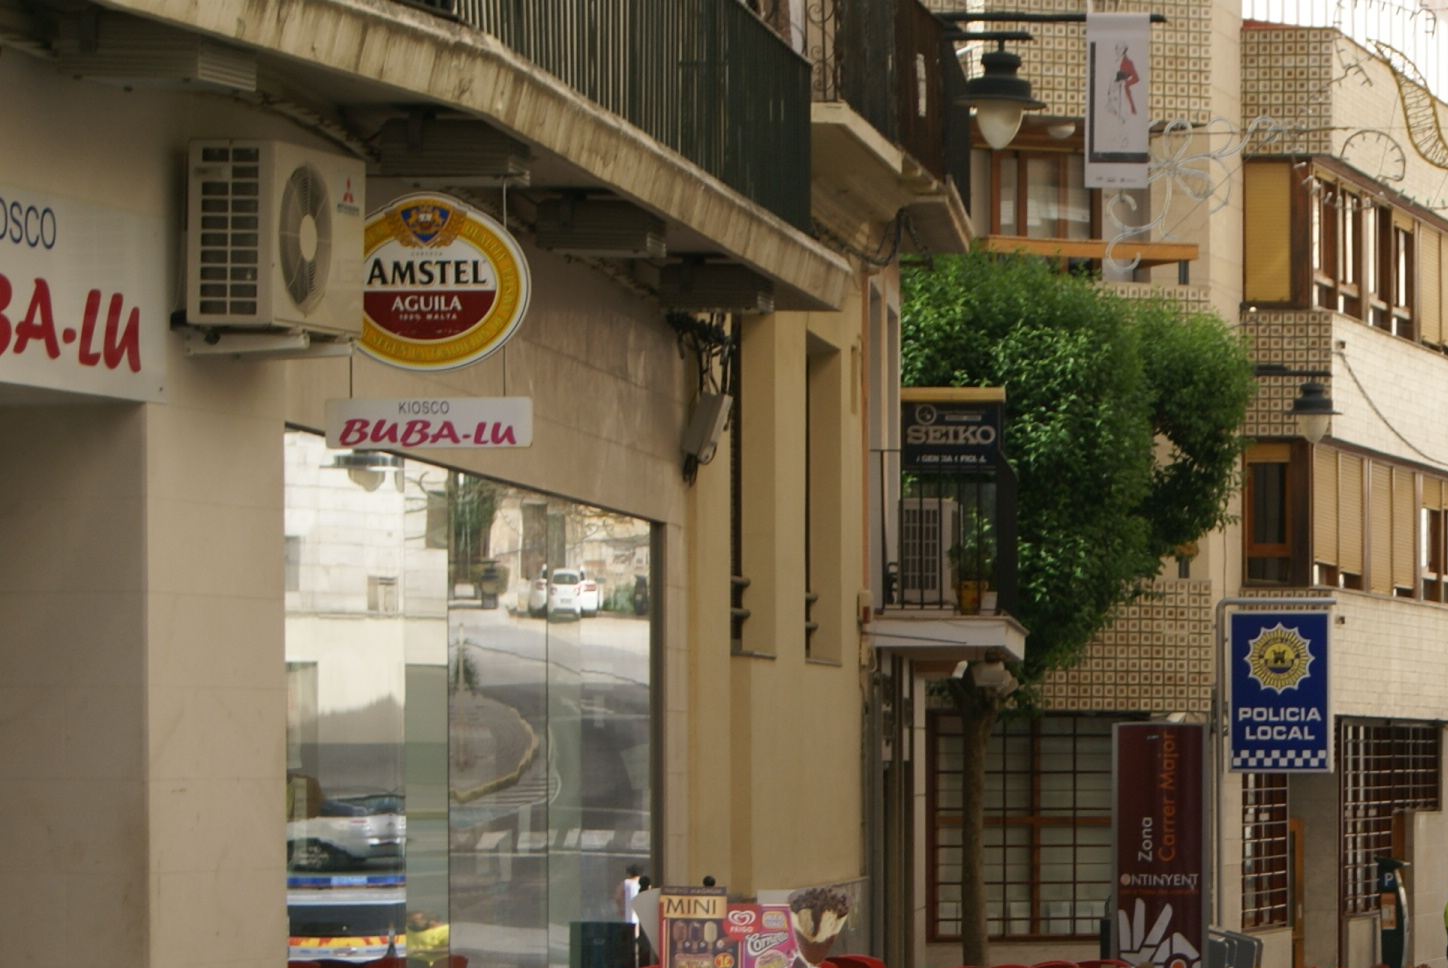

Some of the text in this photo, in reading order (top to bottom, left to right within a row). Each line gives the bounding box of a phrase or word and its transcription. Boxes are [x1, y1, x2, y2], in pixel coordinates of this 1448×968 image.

[366, 257, 487, 287] AMSTEL
[391, 294, 462, 312] AGUILA
[0, 273, 141, 374] A-LU
[426, 313, 457, 321] MALTA
[398, 400, 450, 415] KIOSCO
[338, 418, 517, 448] BUBA-LU
[906, 425, 996, 445] SEIKO
[916, 455, 952, 464] GENIA
[1237, 707, 1322, 721] POLICIA
[1245, 725, 1316, 740] LOCAL
[1157, 731, 1179, 862] Carrer Major
[1138, 816, 1153, 862] Zona
[1120, 873, 1199, 888] ONTINYENT
[1384, 872, 1394, 887] P
[666, 897, 716, 915] MINI
[729, 925, 754, 934] FRIGO
[717, 955, 732, 968] 1€
